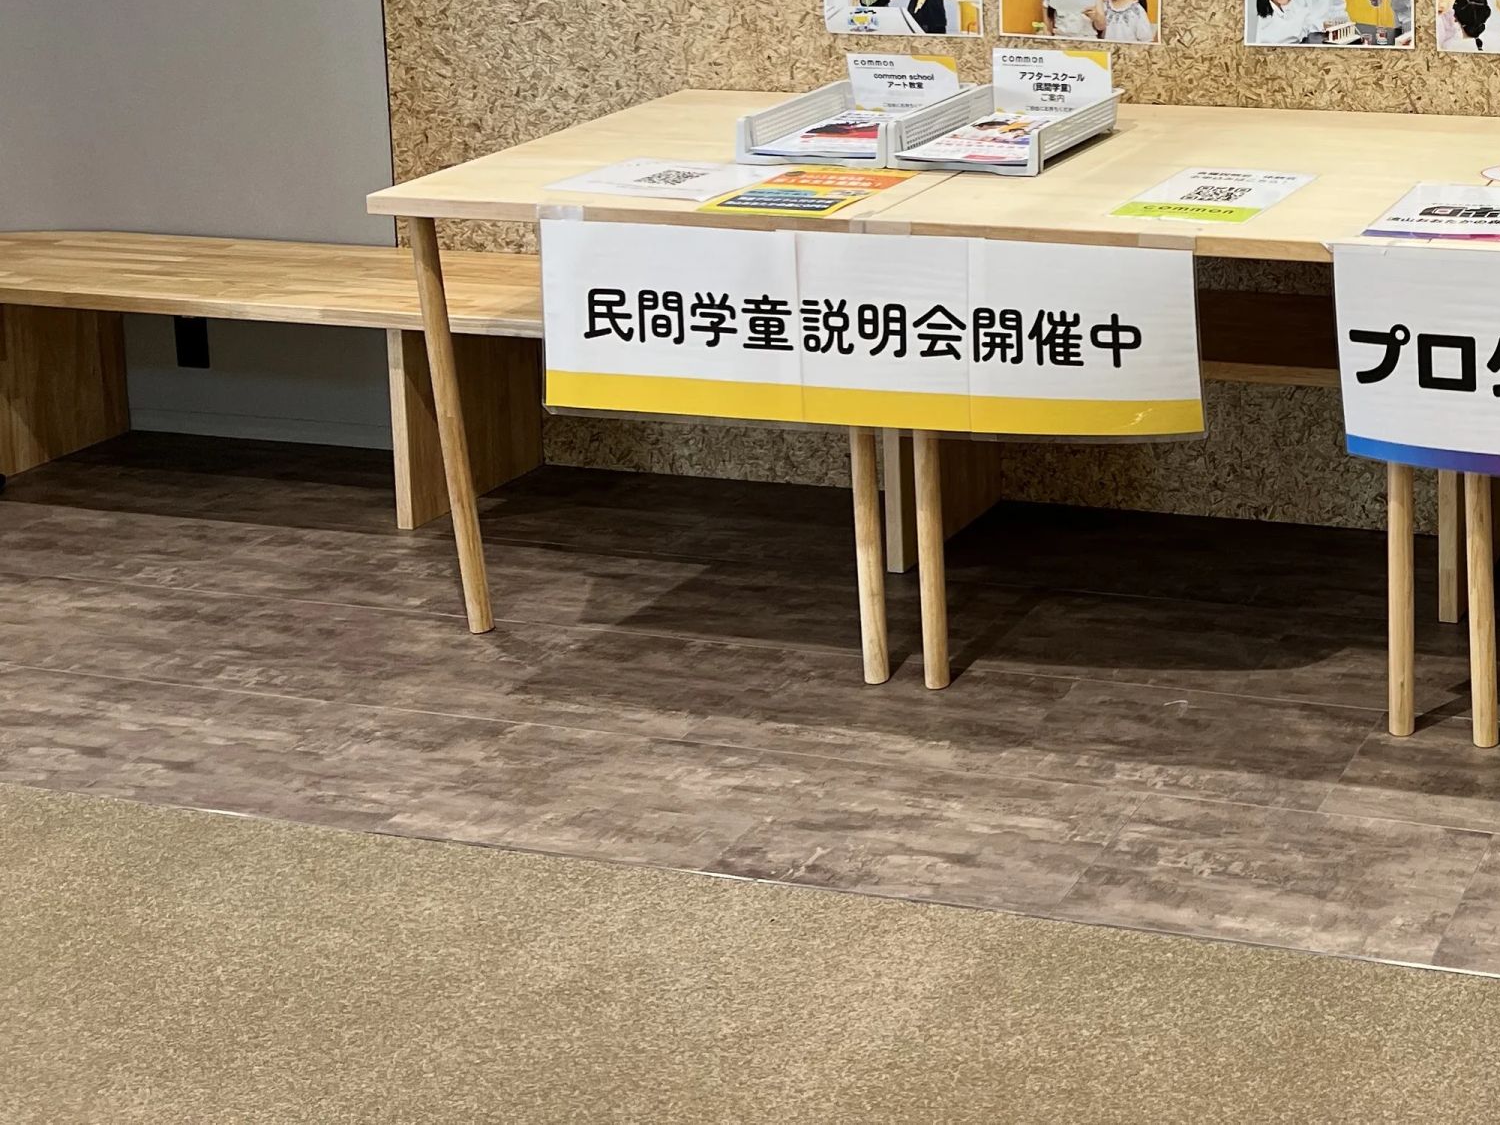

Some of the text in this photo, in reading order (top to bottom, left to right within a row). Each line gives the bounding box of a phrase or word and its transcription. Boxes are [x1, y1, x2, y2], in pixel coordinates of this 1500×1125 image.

[853, 59, 895, 67] common
[1001, 55, 1044, 65] common
[874, 72, 935, 81] common school
[1018, 71, 1085, 83] アフタースクール
[887, 81, 924, 90] アート教室
[1041, 93, 1065, 103] ご案内
[1143, 204, 1235, 214] common
[582, 287, 1144, 370] 民間学童説明会開催中
